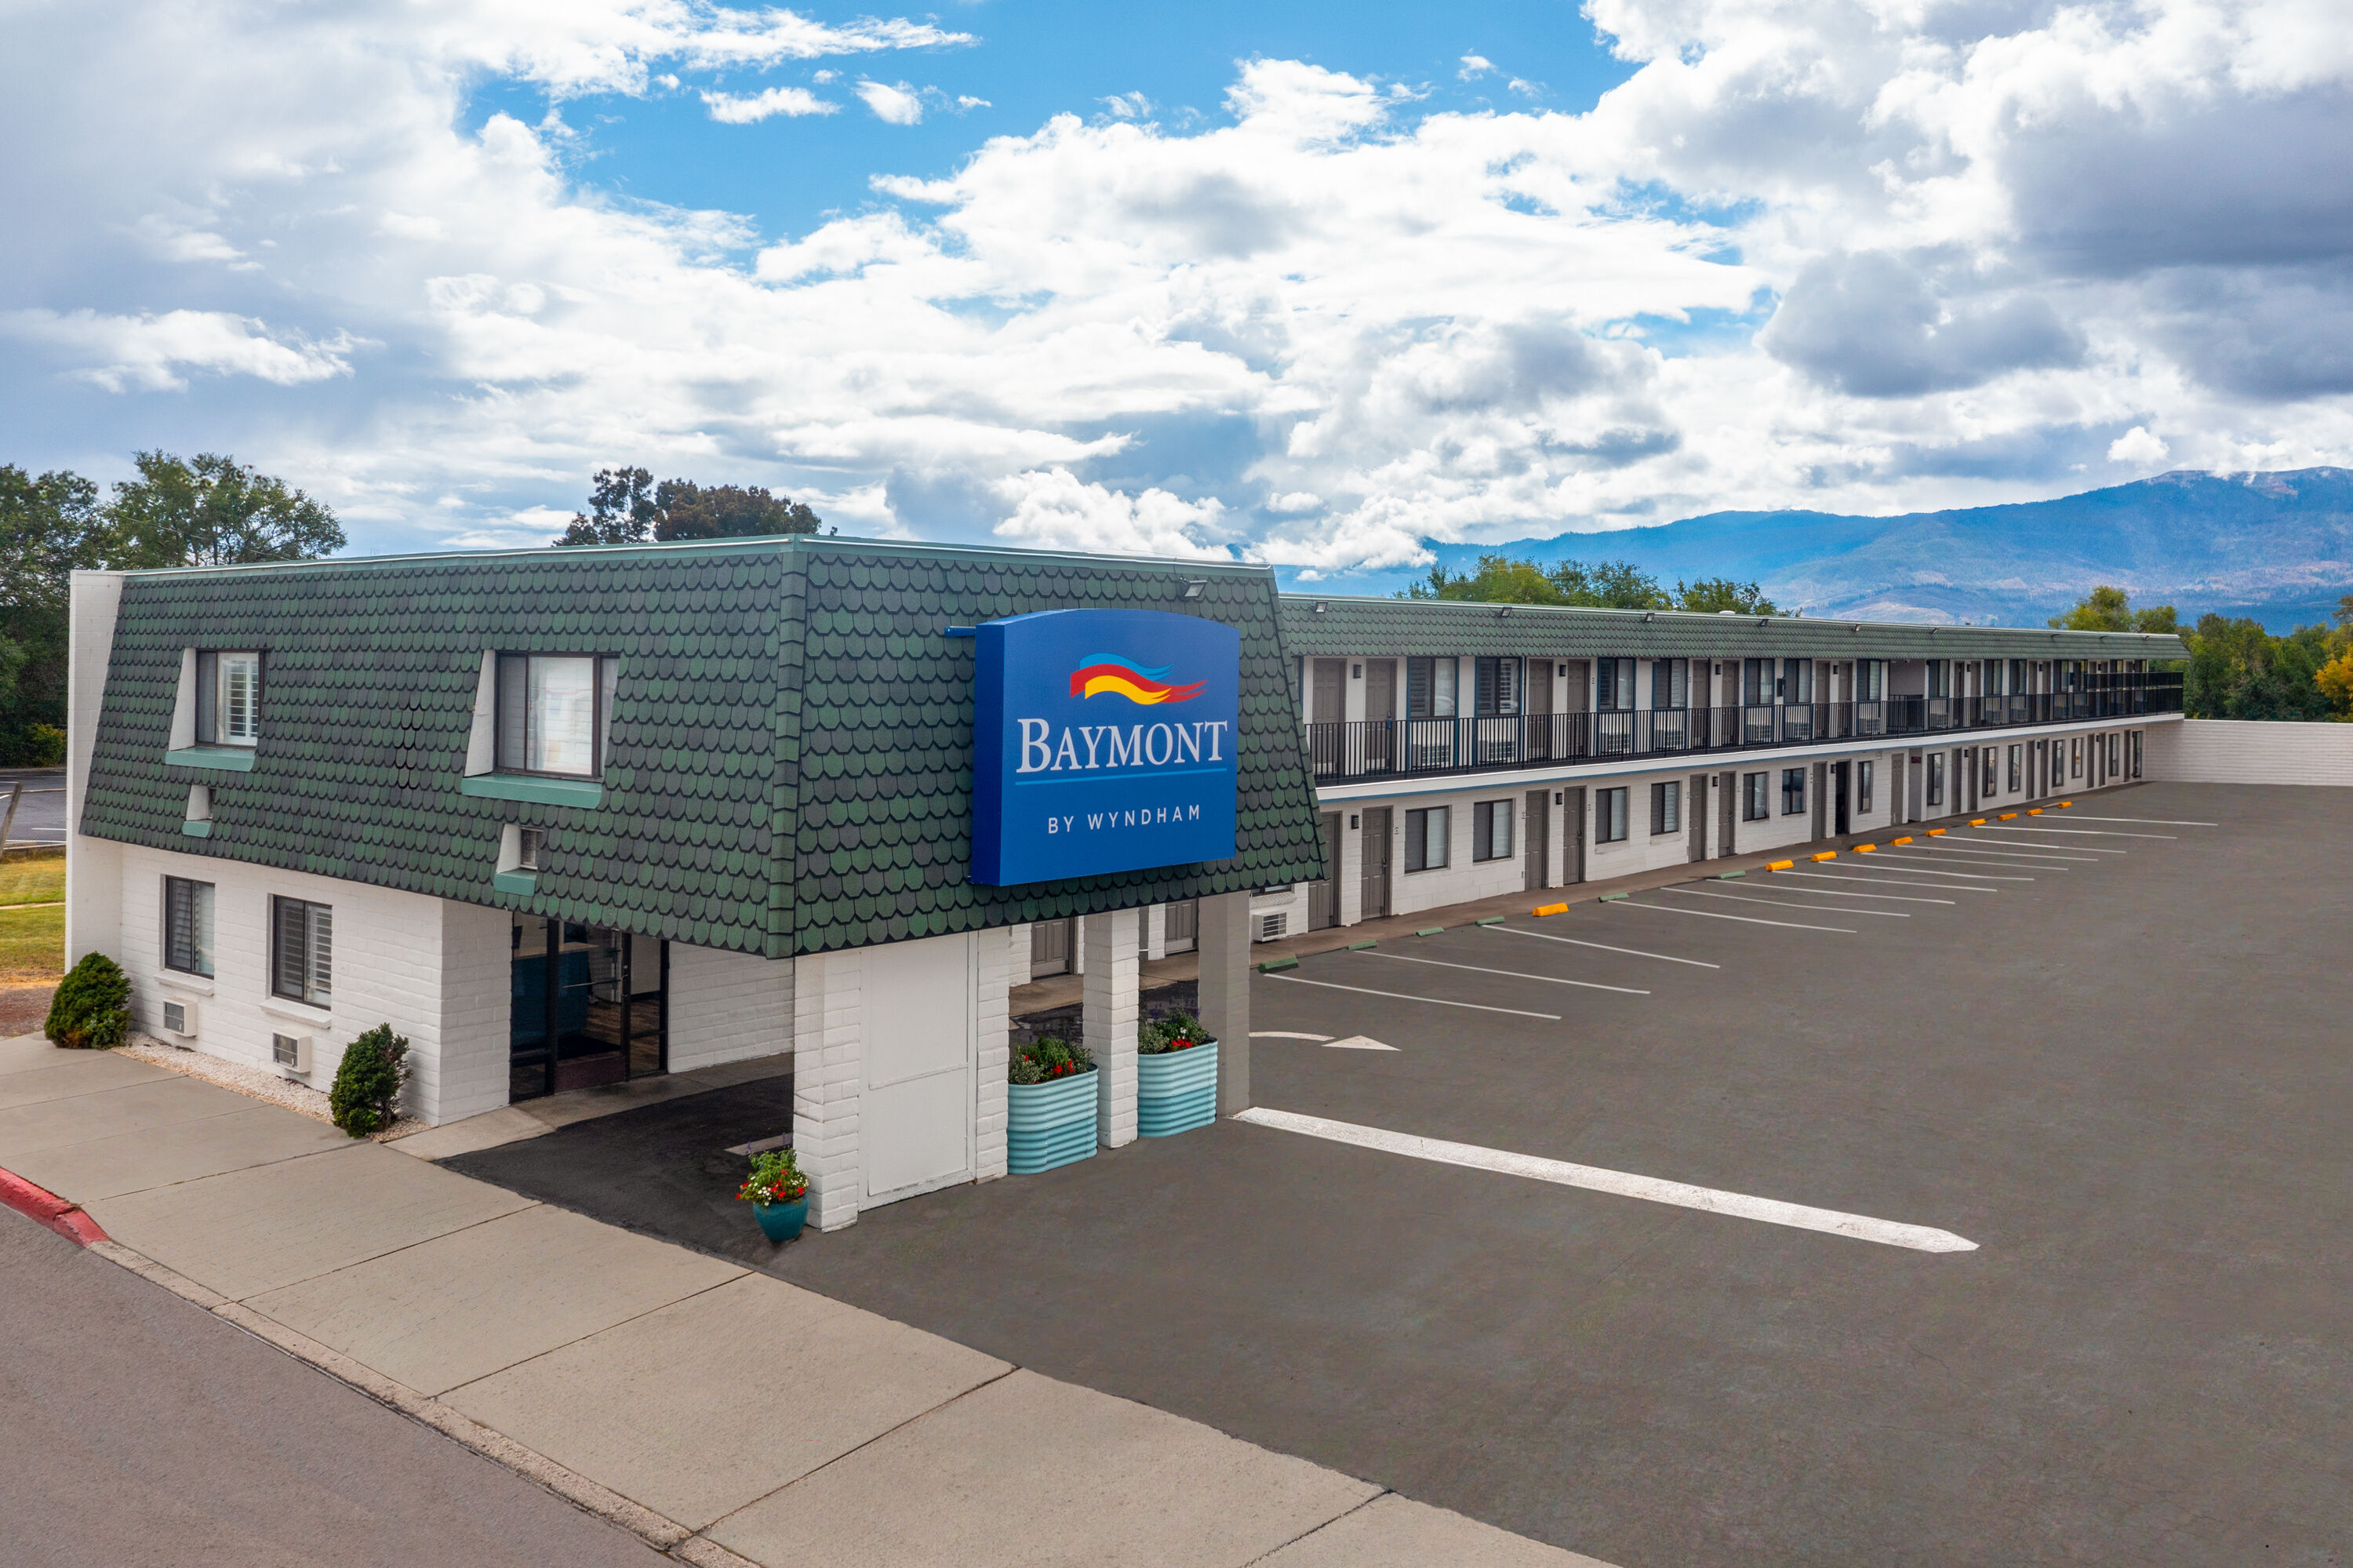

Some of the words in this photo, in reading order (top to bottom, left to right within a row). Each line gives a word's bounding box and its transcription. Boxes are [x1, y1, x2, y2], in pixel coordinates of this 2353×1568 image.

[1016, 718, 1227, 773] BAYMONT
[1048, 816, 1074, 834] BY
[1087, 805, 1199, 830] WYNDHAM
